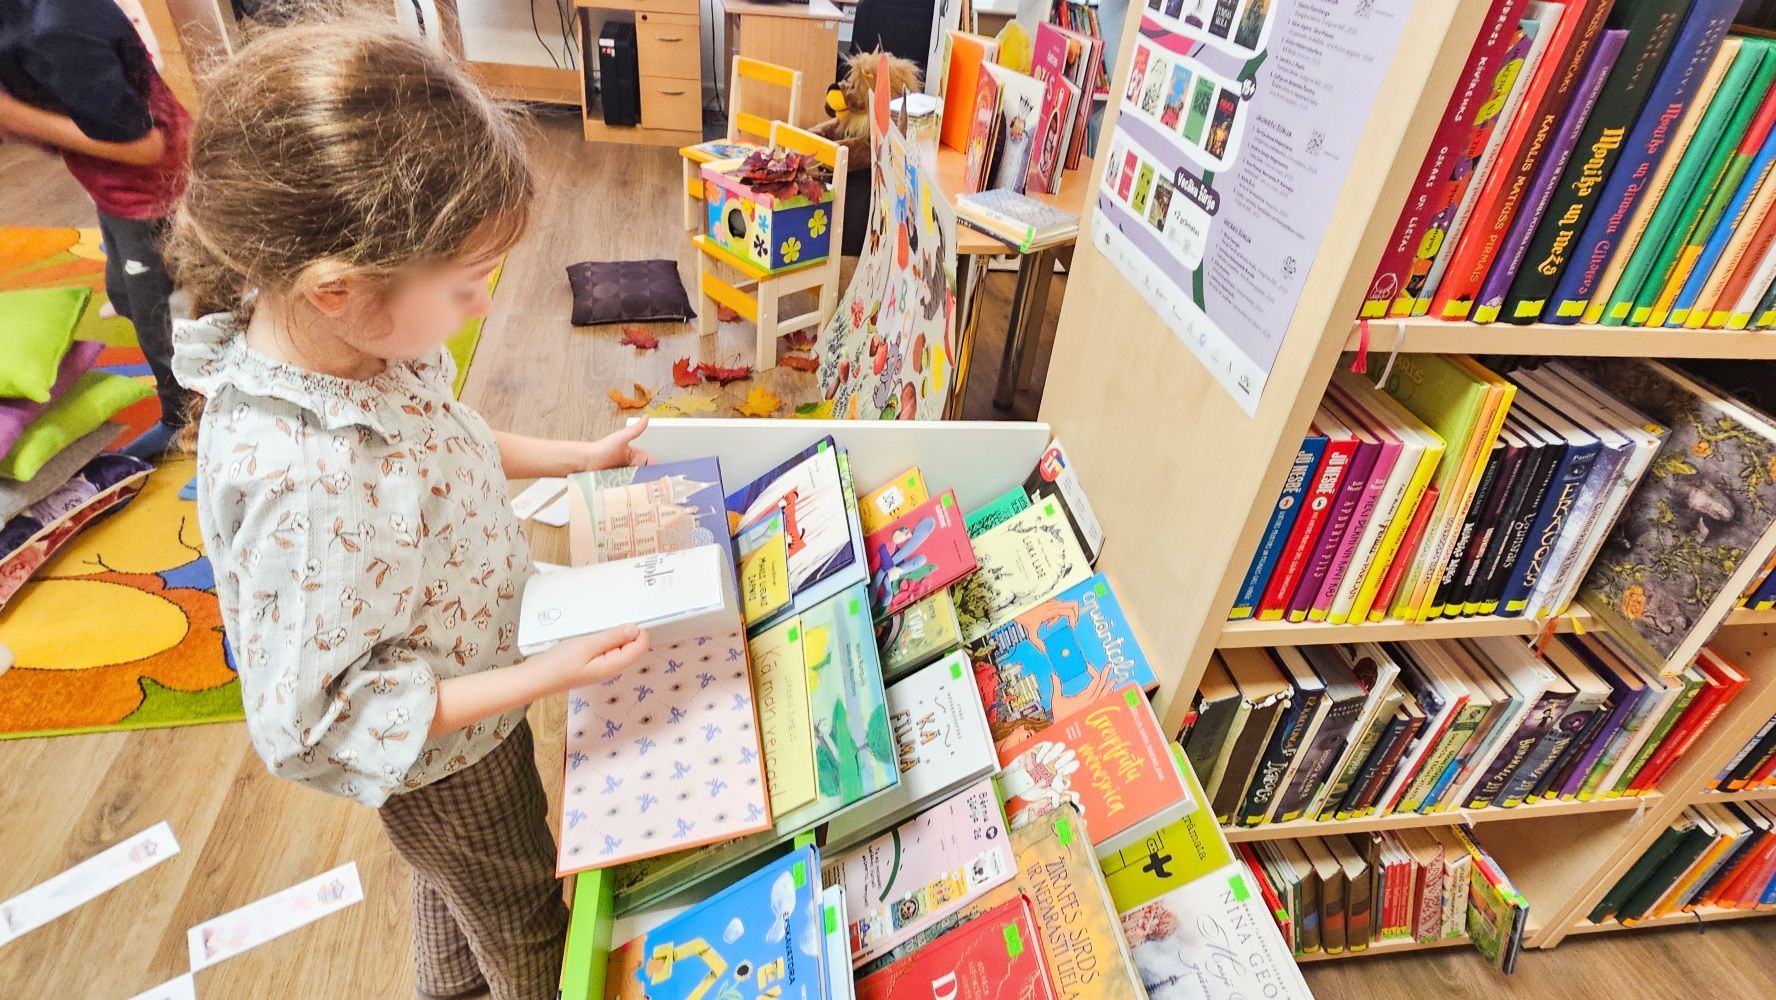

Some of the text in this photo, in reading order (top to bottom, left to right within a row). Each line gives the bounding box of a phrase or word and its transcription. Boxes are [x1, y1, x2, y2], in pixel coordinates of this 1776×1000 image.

[1520, 112, 1555, 173] KARALIS
[1642, 96, 1683, 158] Monika
[1426, 146, 1449, 188] OSKARS
[1535, 117, 1627, 279] Monika un mežs
[1398, 216, 1419, 253] LIETAS
[1467, 232, 1499, 284] PIRMAIS
[1282, 461, 1309, 498] NESBĒ
[1315, 461, 1343, 498] NESBĒ
[1523, 482, 1580, 587] ERAGONS
[750, 646, 785, 677] Kā
[755, 679, 782, 721] man
[889, 709, 920, 774] FILMĀ
[916, 711, 941, 746] KĀ
[1027, 862, 1043, 880] IR
[1033, 880, 1069, 957] NEPARASTI
[1045, 855, 1100, 984] ŽIRAFES SIRDS
[1219, 889, 1251, 944] NINA
